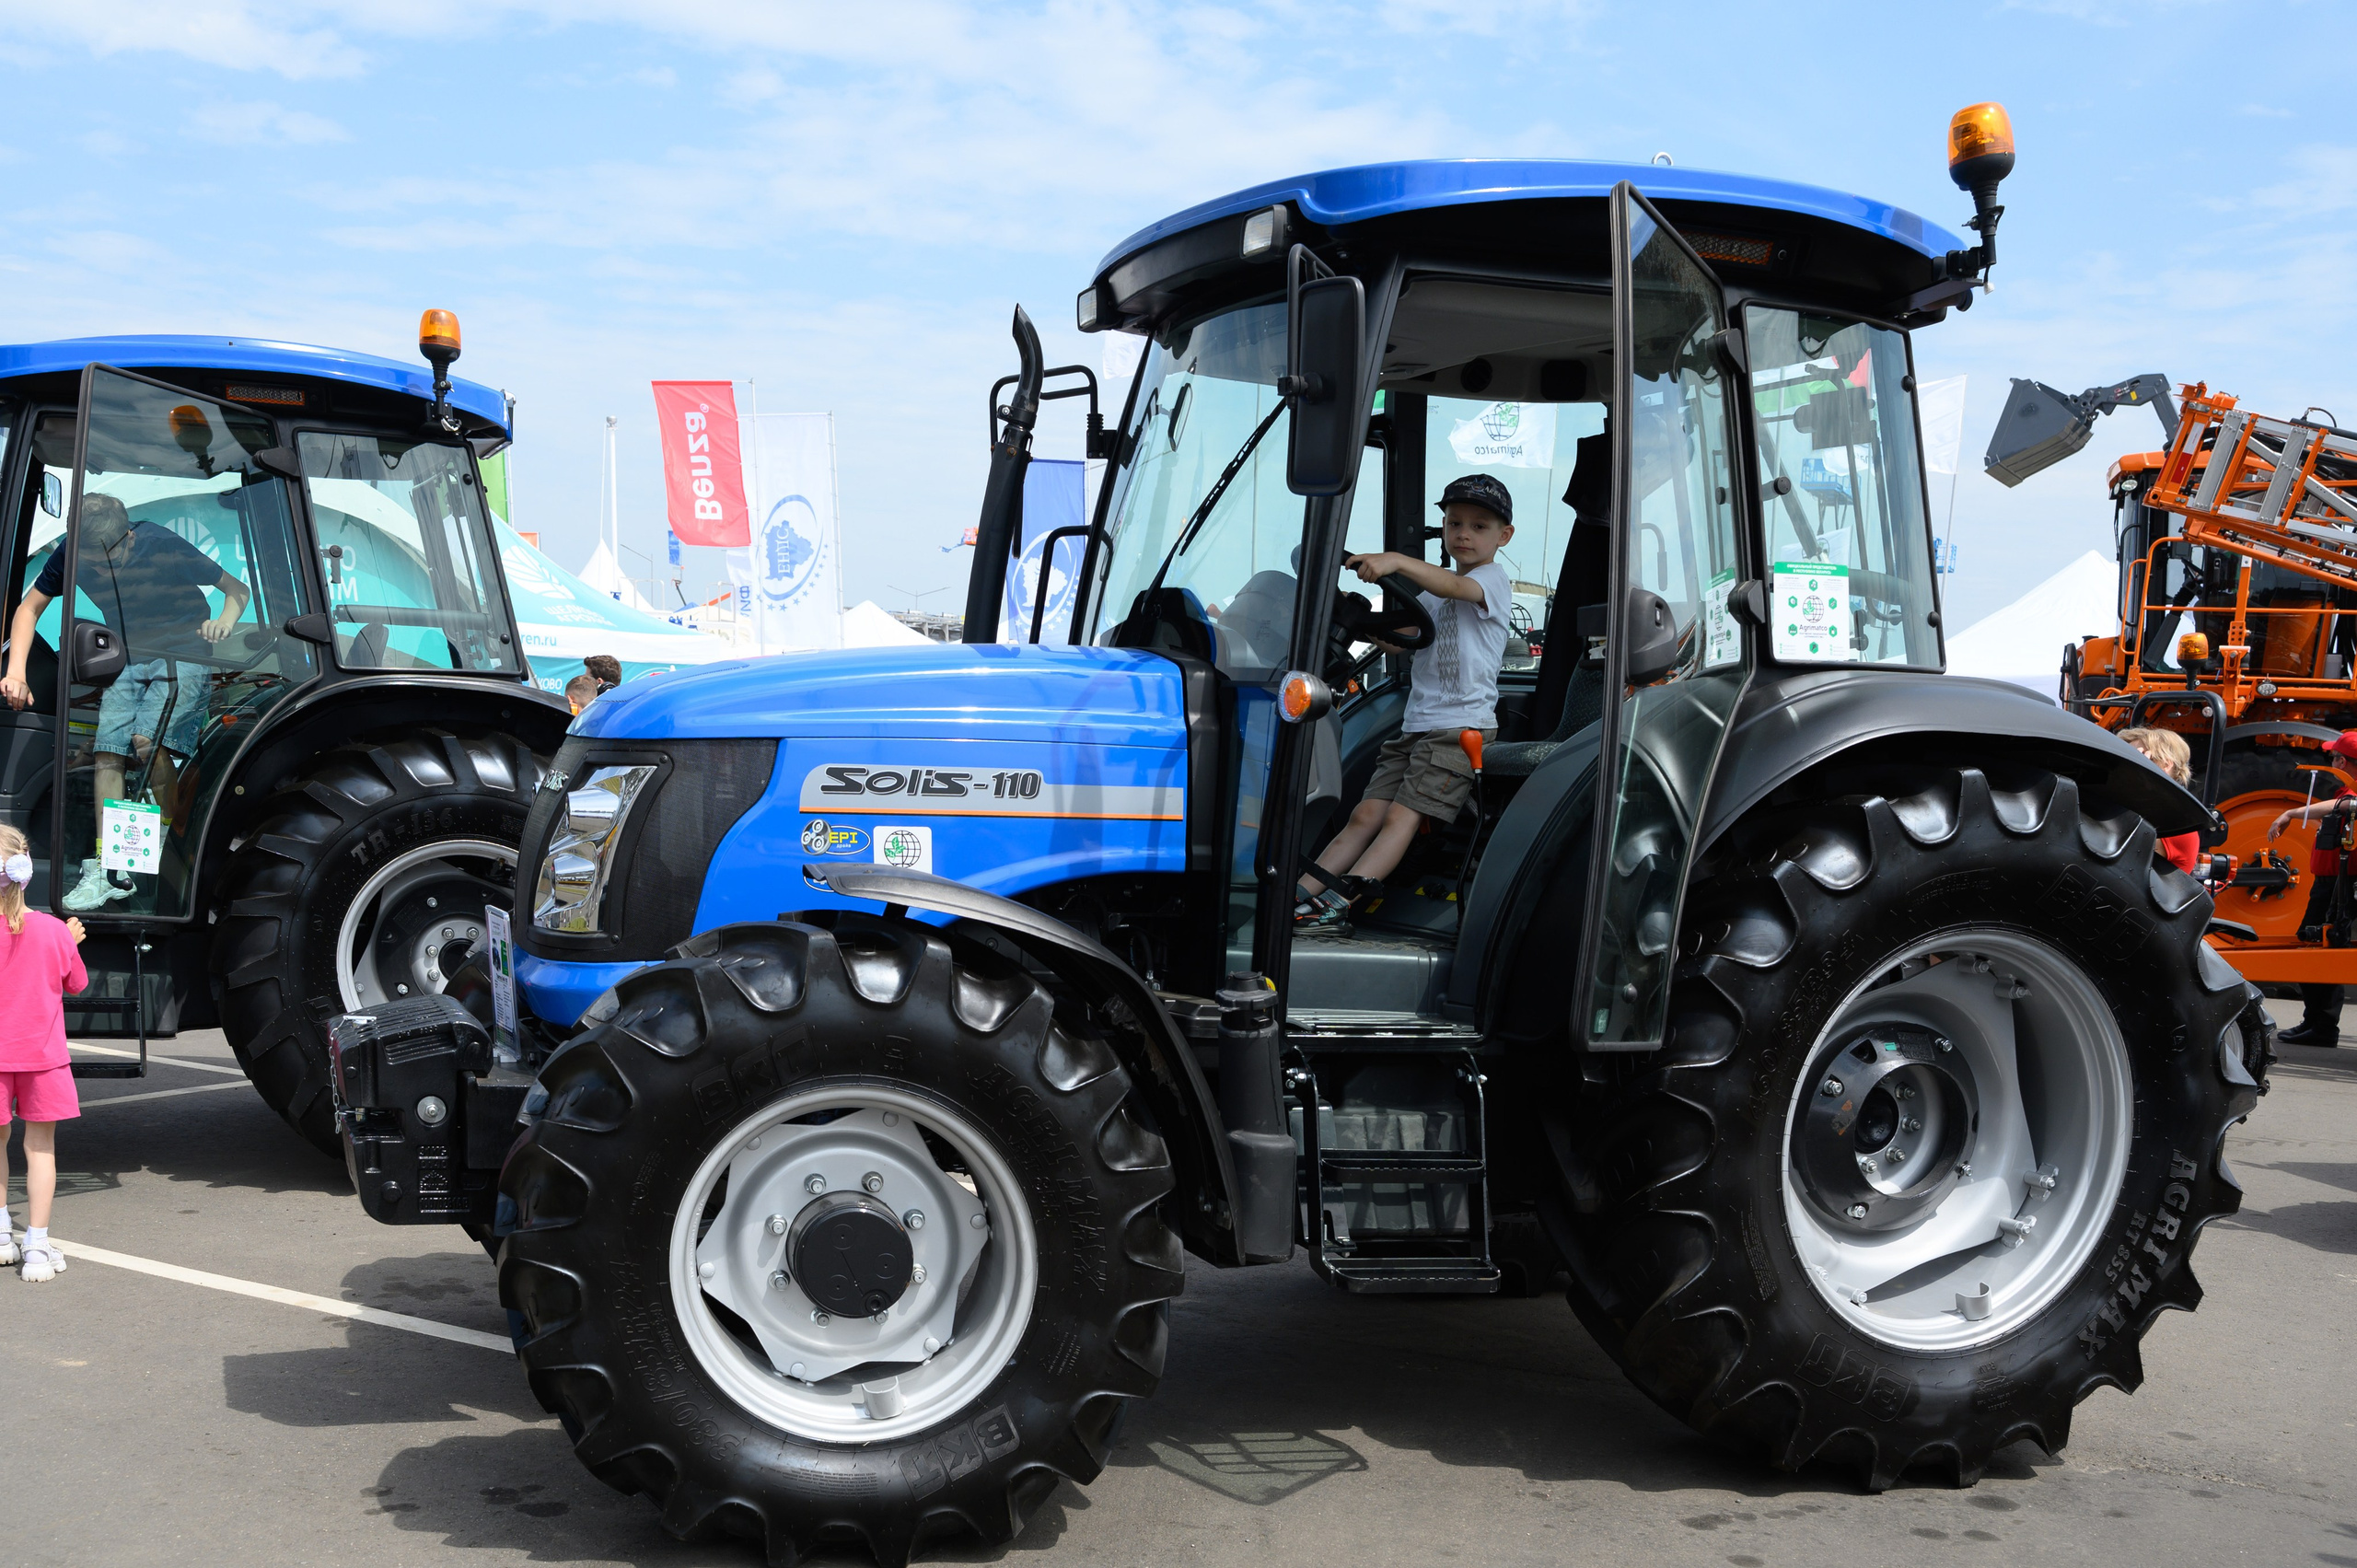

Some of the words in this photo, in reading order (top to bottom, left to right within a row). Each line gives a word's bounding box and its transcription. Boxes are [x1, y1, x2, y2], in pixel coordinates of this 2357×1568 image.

[830, 831, 858, 844] EPI
[2105, 1247, 2134, 1287] 855
[905, 1408, 1018, 1496] BKT
